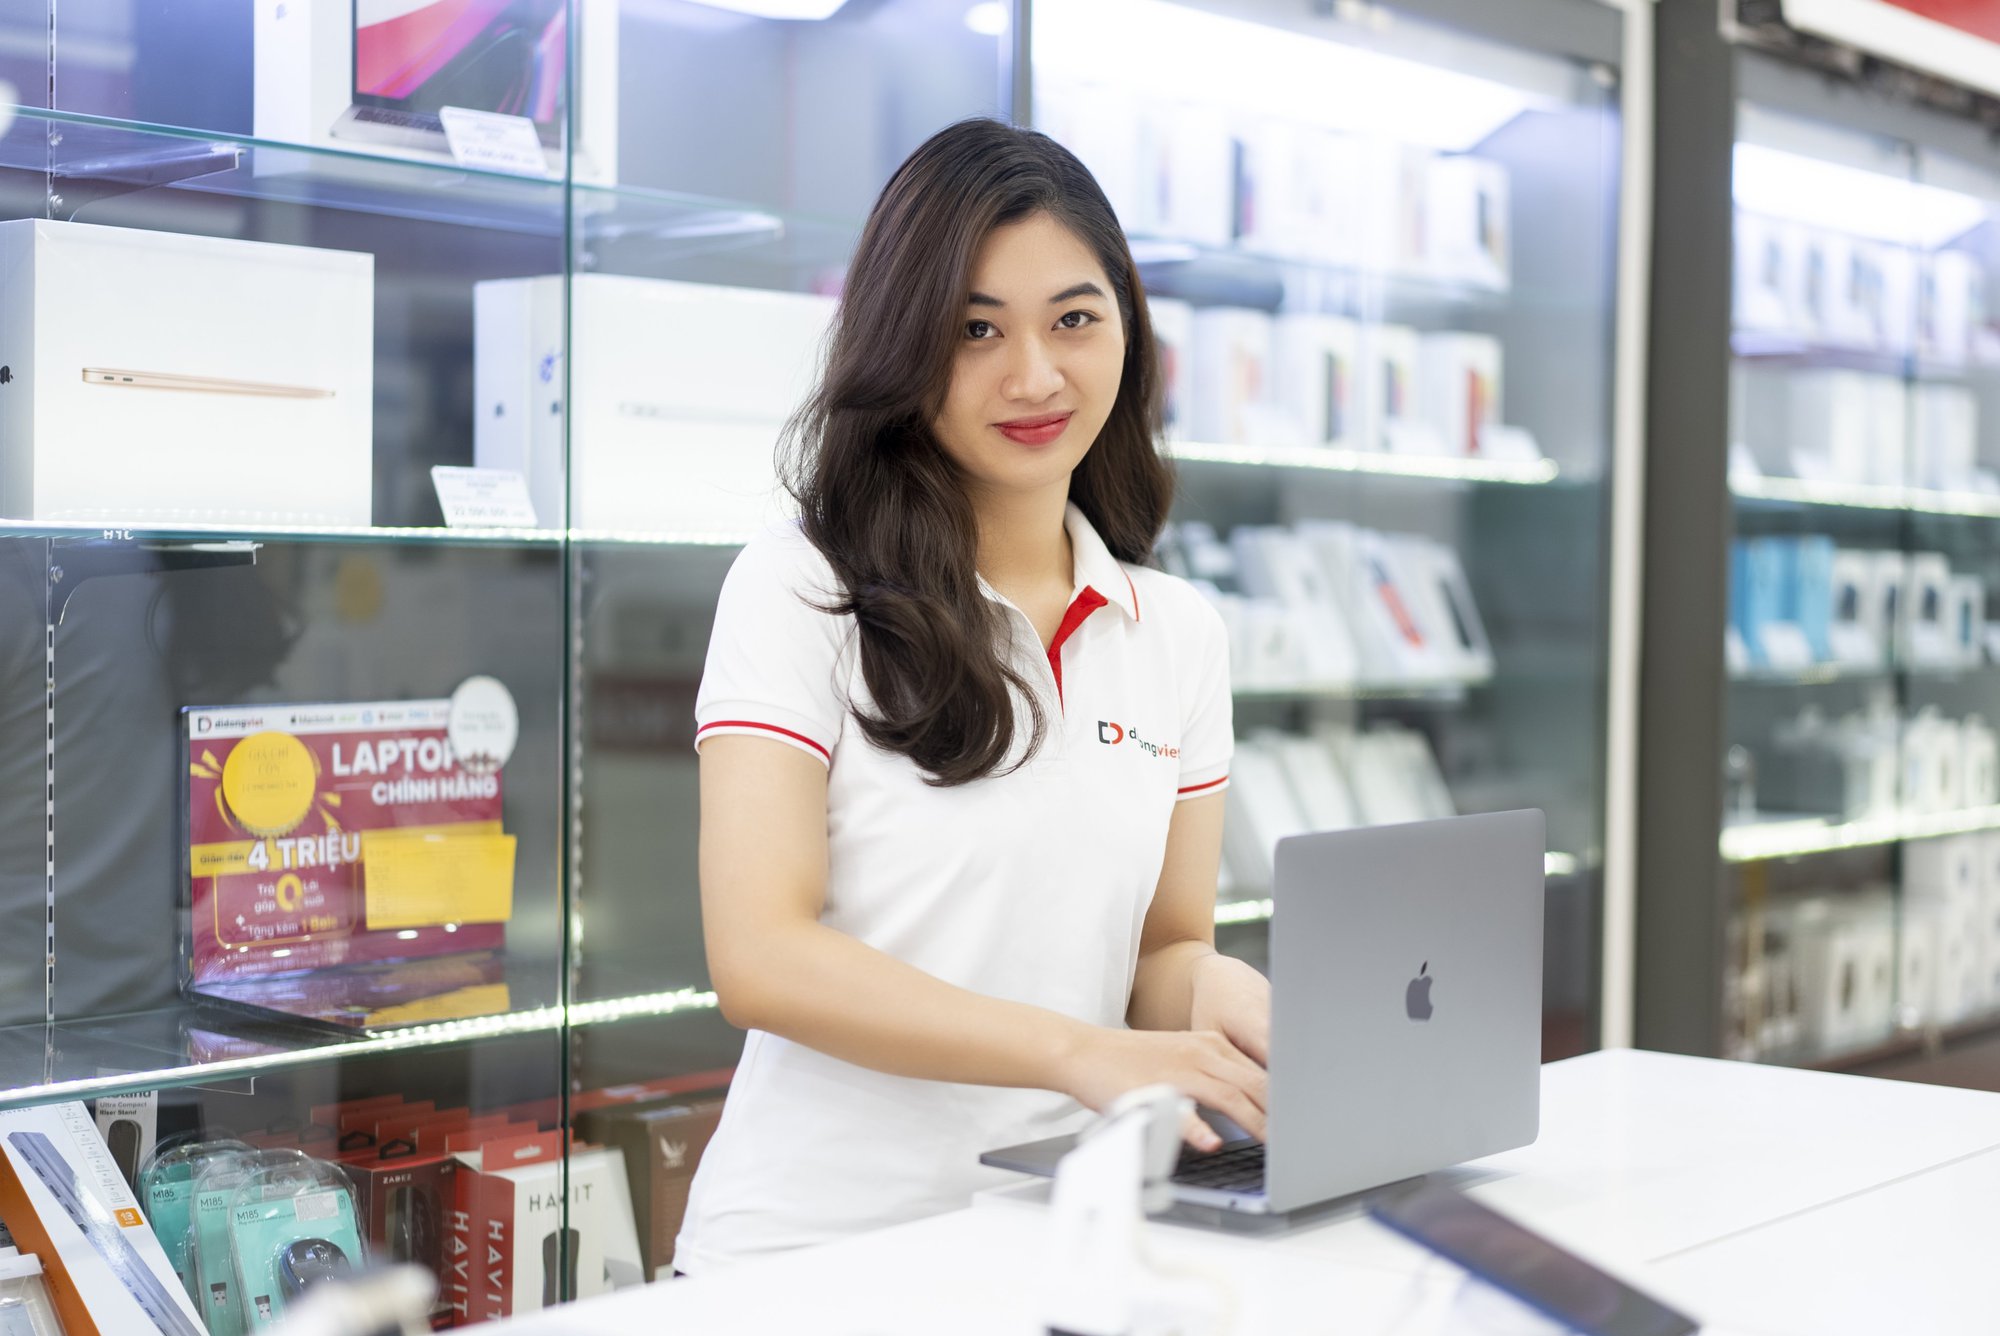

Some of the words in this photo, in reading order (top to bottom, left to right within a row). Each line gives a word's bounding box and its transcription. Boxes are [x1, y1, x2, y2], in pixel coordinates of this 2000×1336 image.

[214, 718, 263, 730] didongviet
[248, 841, 270, 871] 4
[276, 827, 360, 873] TRIỆU
[153, 1188, 175, 1200] M185
[200, 1196, 223, 1208] M185
[237, 1209, 259, 1221] M185
[453, 1210, 470, 1318] HAVIT
